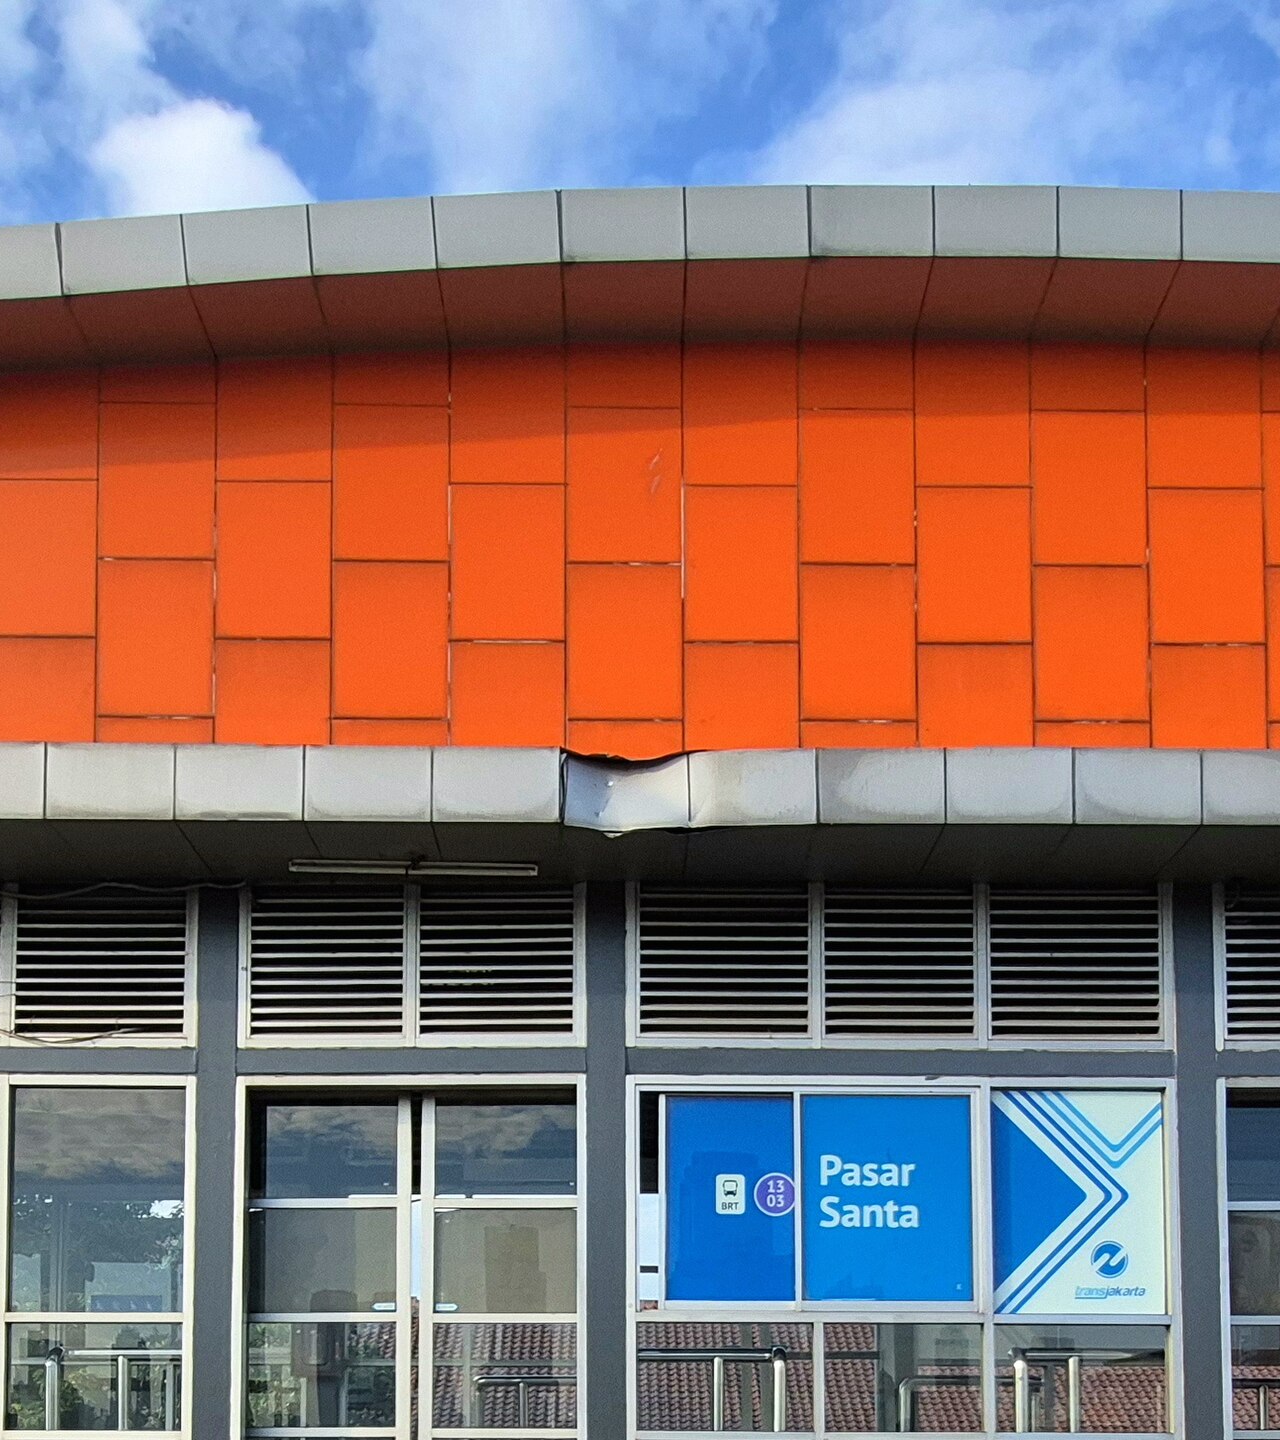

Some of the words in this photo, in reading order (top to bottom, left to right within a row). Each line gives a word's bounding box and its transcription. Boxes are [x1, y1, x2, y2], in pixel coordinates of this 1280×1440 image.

[820, 1154, 916, 1187] Pasar
[767, 1180, 785, 1193] 13
[721, 1202, 739, 1210] BRT
[766, 1194, 785, 1207] 03
[819, 1195, 920, 1228] Santa
[1075, 1286, 1146, 1299] transjakarta
